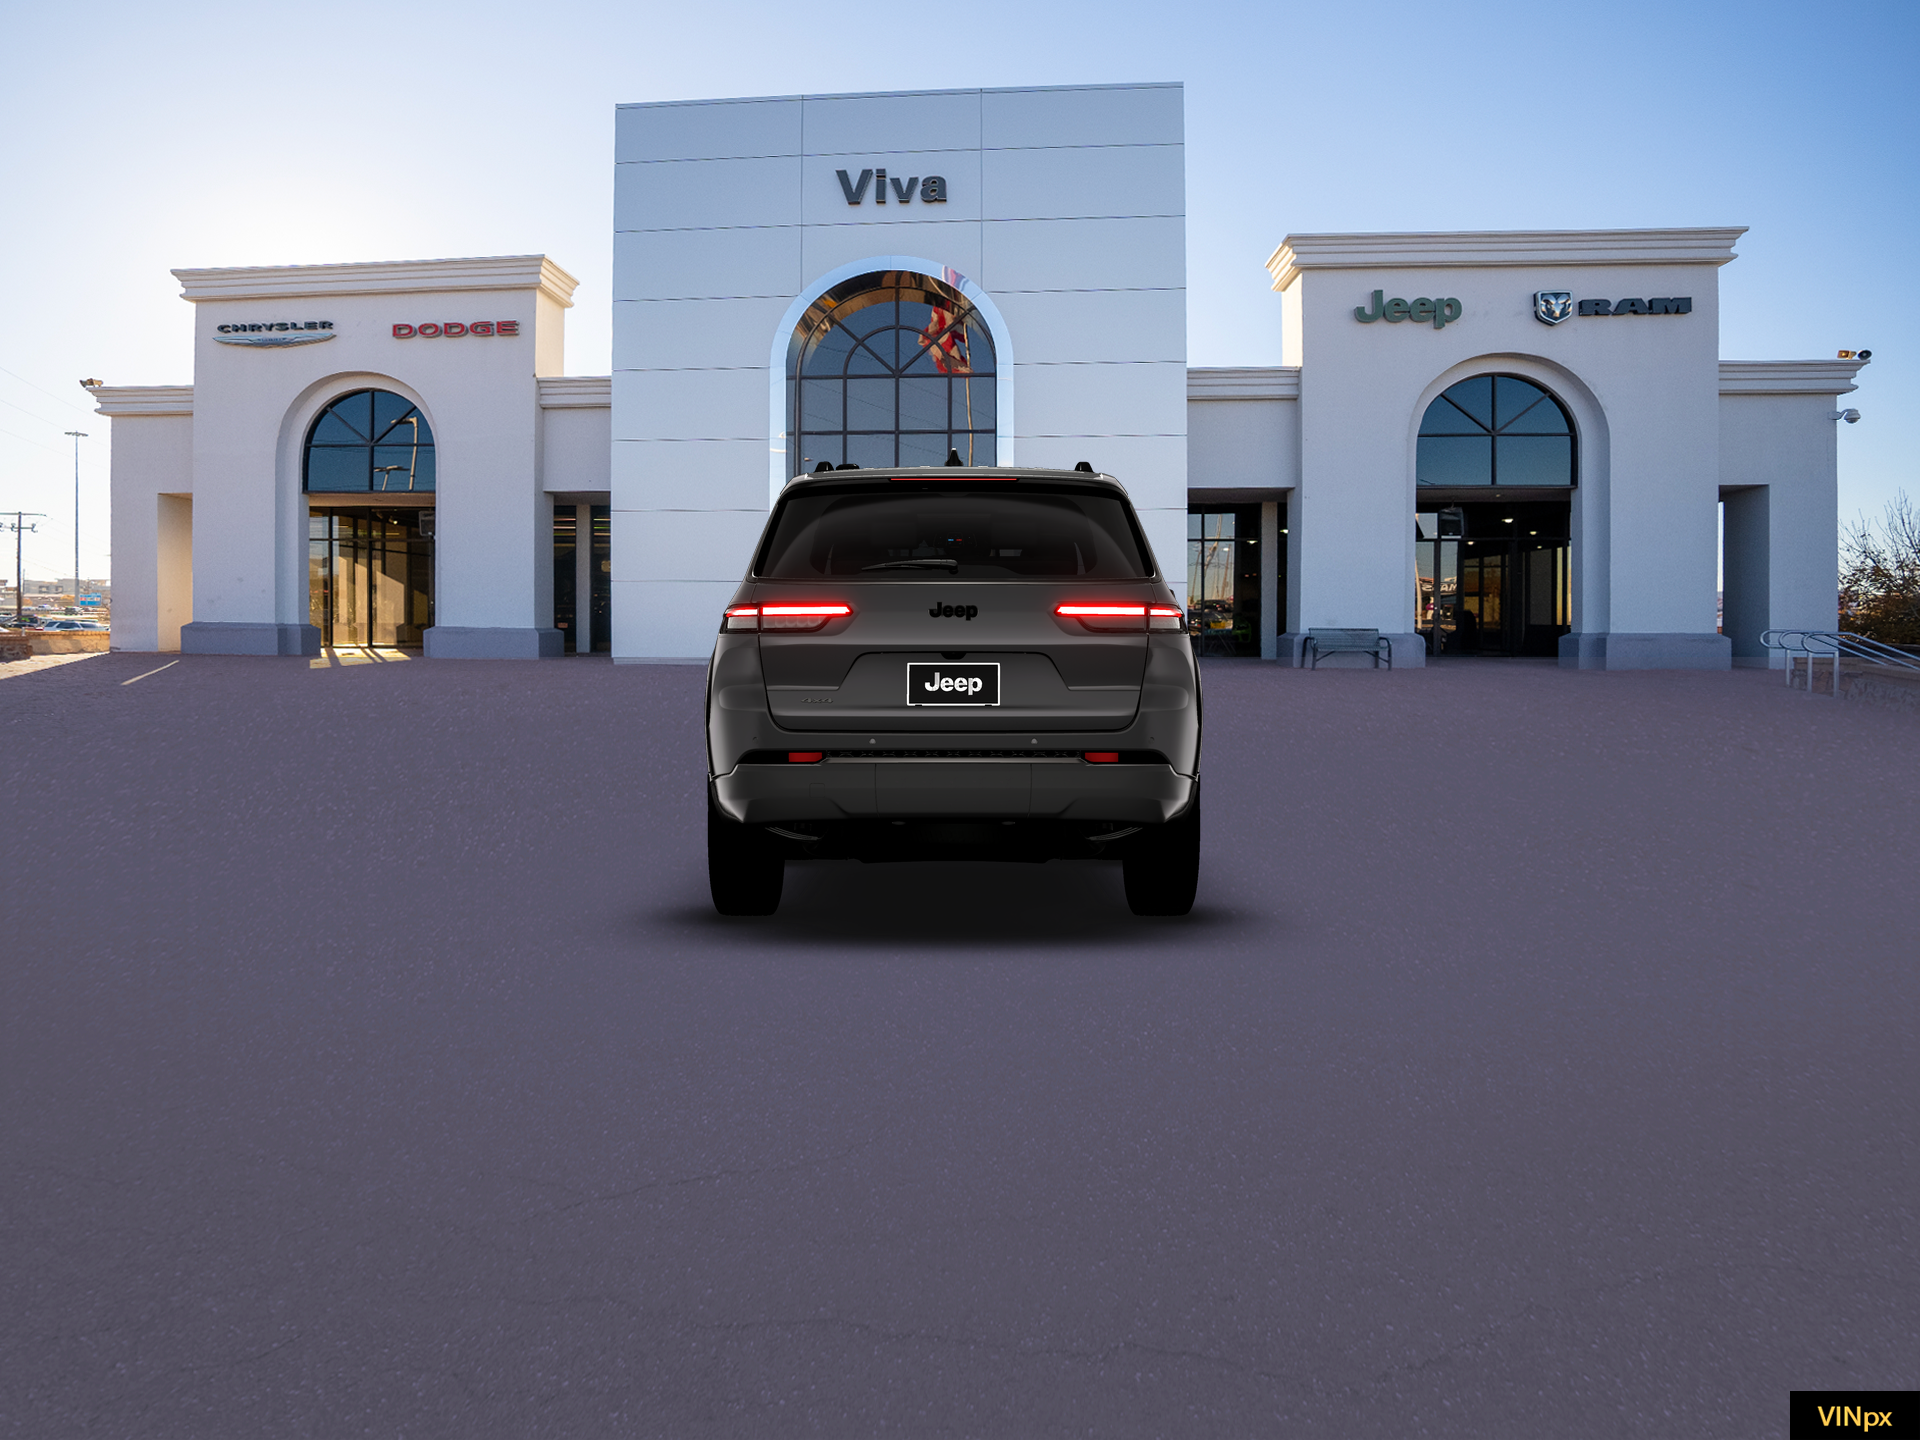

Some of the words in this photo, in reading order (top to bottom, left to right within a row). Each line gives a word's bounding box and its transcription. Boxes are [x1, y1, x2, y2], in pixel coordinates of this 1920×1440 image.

[835, 168, 947, 205] Viva
[1353, 289, 1463, 330] Jeep
[1578, 297, 1692, 316] RAM
[217, 321, 334, 333] CHRYSLER
[392, 320, 519, 339] DODGE
[928, 602, 979, 621] Jeep
[924, 672, 983, 696] Jeep
